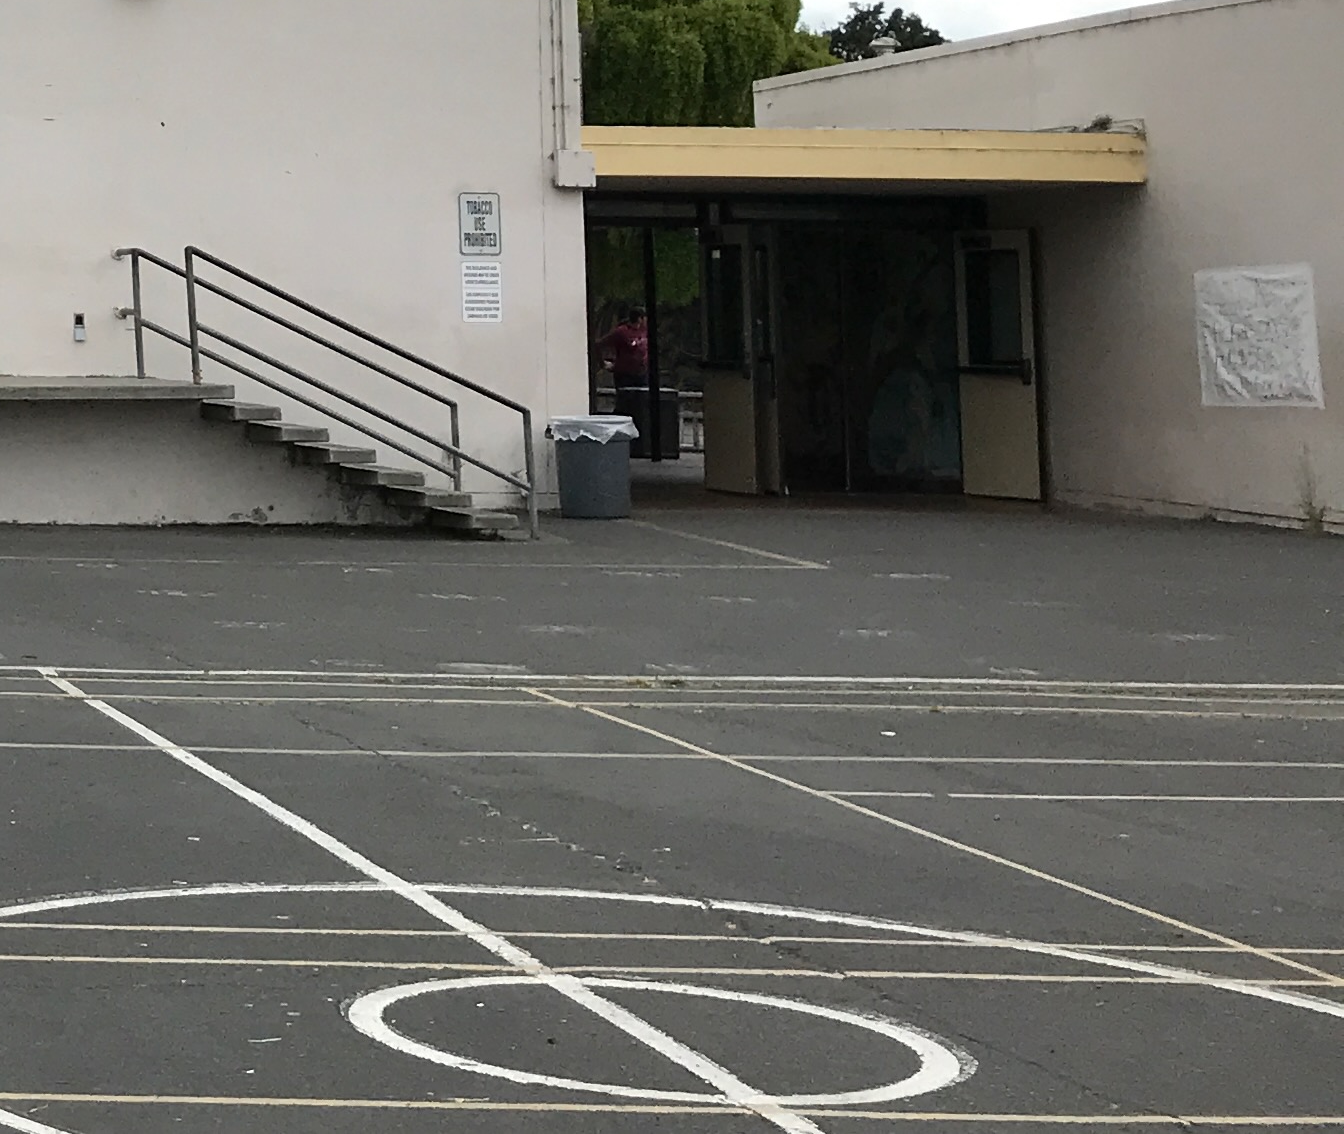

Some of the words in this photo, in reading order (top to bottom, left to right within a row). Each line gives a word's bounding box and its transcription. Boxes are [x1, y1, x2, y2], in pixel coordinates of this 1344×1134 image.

[466, 200, 493, 215] TOBACCO
[474, 216, 486, 231] USE
[463, 232, 497, 247] PROHIBITED
